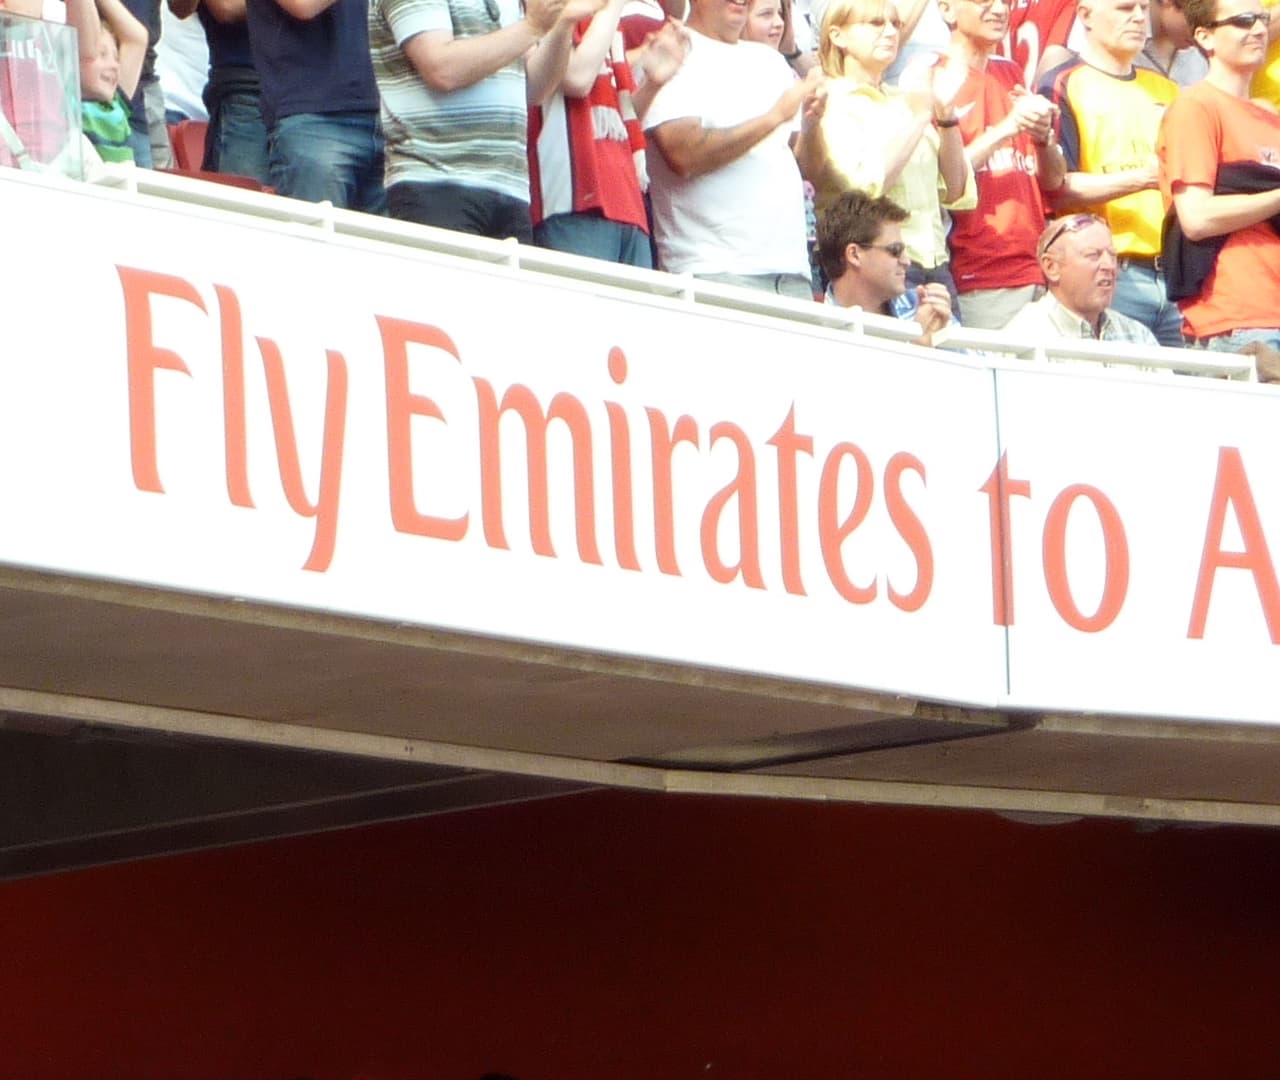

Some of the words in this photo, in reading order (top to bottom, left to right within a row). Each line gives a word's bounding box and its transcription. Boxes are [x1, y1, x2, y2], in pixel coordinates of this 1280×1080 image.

[115, 264, 349, 574] Fly
[374, 313, 935, 613] Emirates
[979, 448, 1130, 634] to
